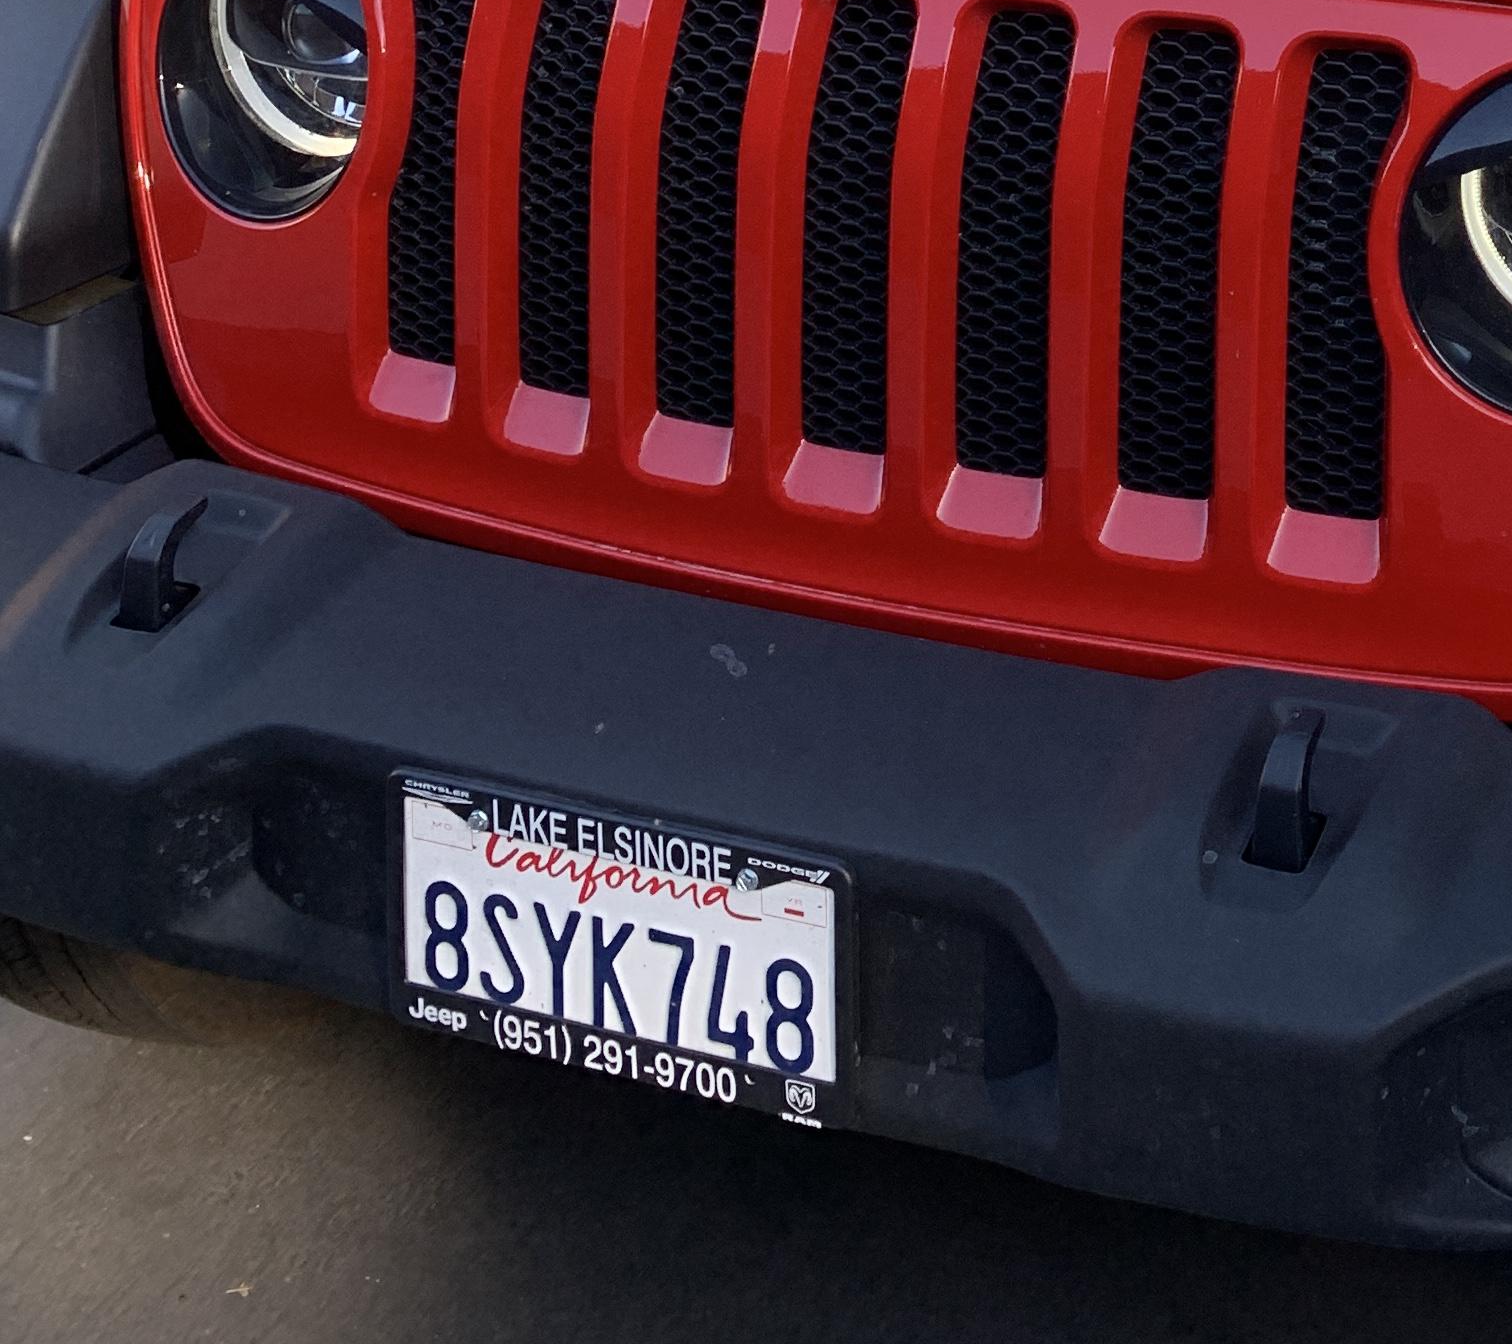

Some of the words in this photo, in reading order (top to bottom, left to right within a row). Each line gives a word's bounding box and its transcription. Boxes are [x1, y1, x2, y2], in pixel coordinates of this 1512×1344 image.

[405, 779, 470, 799] CHRYSLER
[492, 798, 569, 850] LAKE
[577, 817, 734, 887] ELSINORE
[747, 857, 820, 882] DODGE
[485, 833, 762, 922] California
[424, 880, 815, 1075] 8SYK748
[408, 997, 468, 1032] Jeep
[493, 1010, 572, 1065] (951)
[583, 1034, 737, 1103] 291-9700
[781, 1113, 822, 1129] RAM
